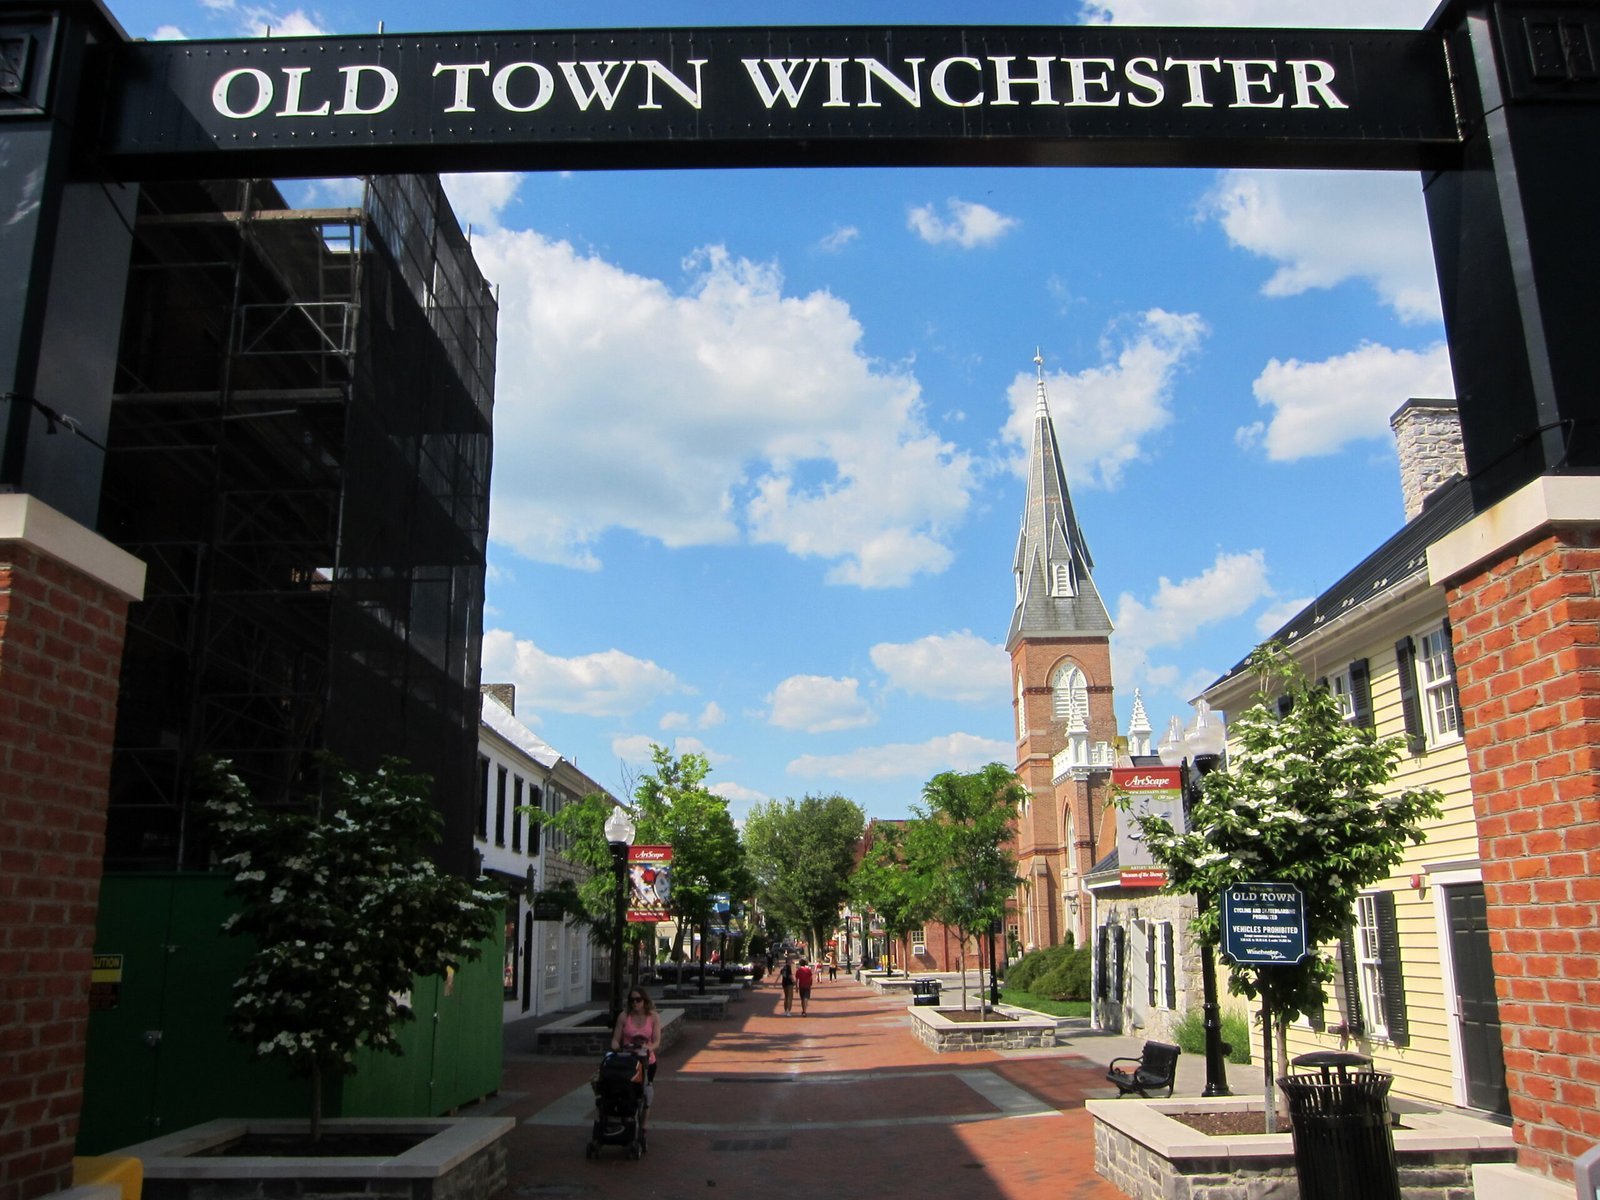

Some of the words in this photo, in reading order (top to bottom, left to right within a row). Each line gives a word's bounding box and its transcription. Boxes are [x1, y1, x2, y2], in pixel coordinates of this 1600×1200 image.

[211, 65, 399, 119] OLD
[432, 59, 708, 114] TOWN
[741, 56, 1349, 109] WINCHESTER
[1125, 775, 1170, 787] ArtScape
[635, 850, 665, 859] ArtScape
[1233, 892, 1257, 901] OLD
[1260, 892, 1295, 902] TOWN
[1232, 925, 1261, 933] VEHICLES
[1263, 926, 1298, 934] PROHIBITED
